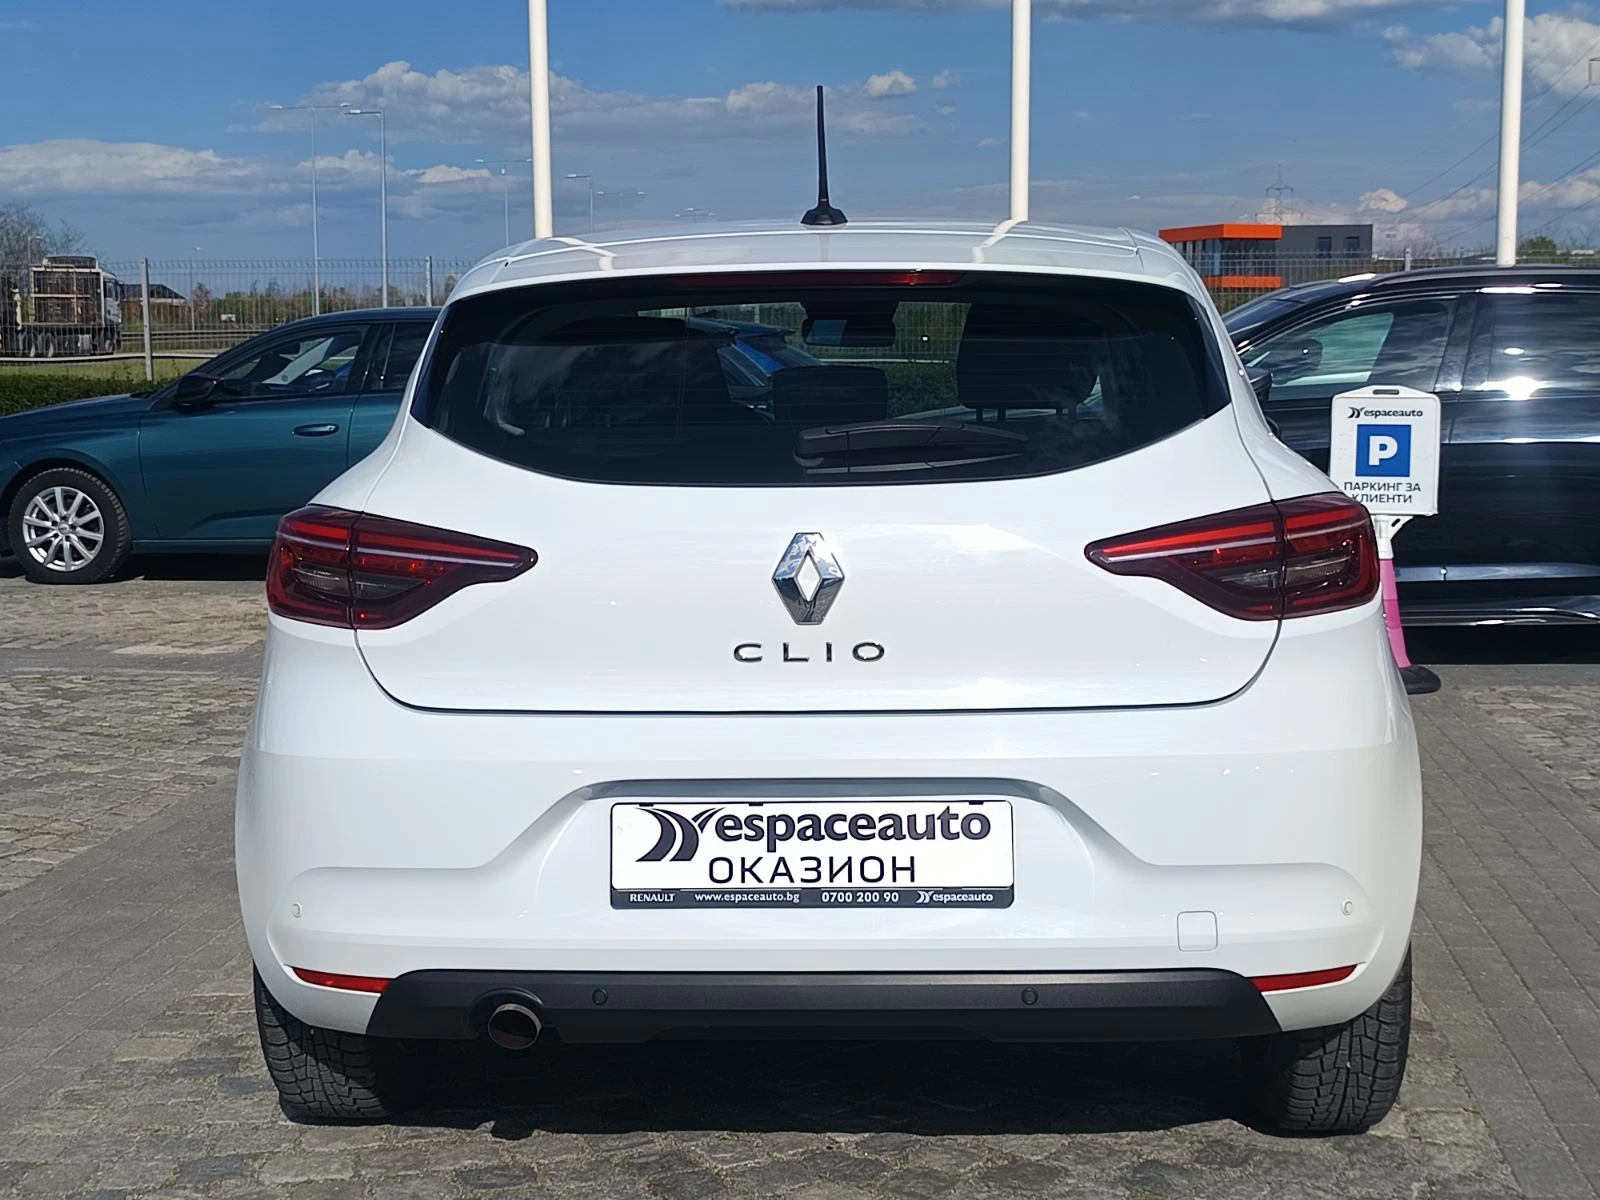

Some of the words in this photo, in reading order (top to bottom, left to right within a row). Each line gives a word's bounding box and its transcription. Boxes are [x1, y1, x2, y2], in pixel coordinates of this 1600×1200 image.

[1363, 409, 1424, 419] espaceauto
[1368, 435, 1398, 466] P
[1343, 481, 1402, 491] ПАРКИНГ
[1405, 483, 1421, 492] ЗА
[733, 641, 885, 663] CLIO
[714, 805, 991, 853] espaceauto
[708, 855, 916, 884] ОКАЗИОН
[629, 893, 676, 902] RENAULT
[694, 892, 800, 903] www.espaceauto.bg
[821, 891, 852, 903] 0700
[856, 891, 880, 903] 200
[883, 891, 899, 903] 90
[932, 892, 993, 904] espaceauto
